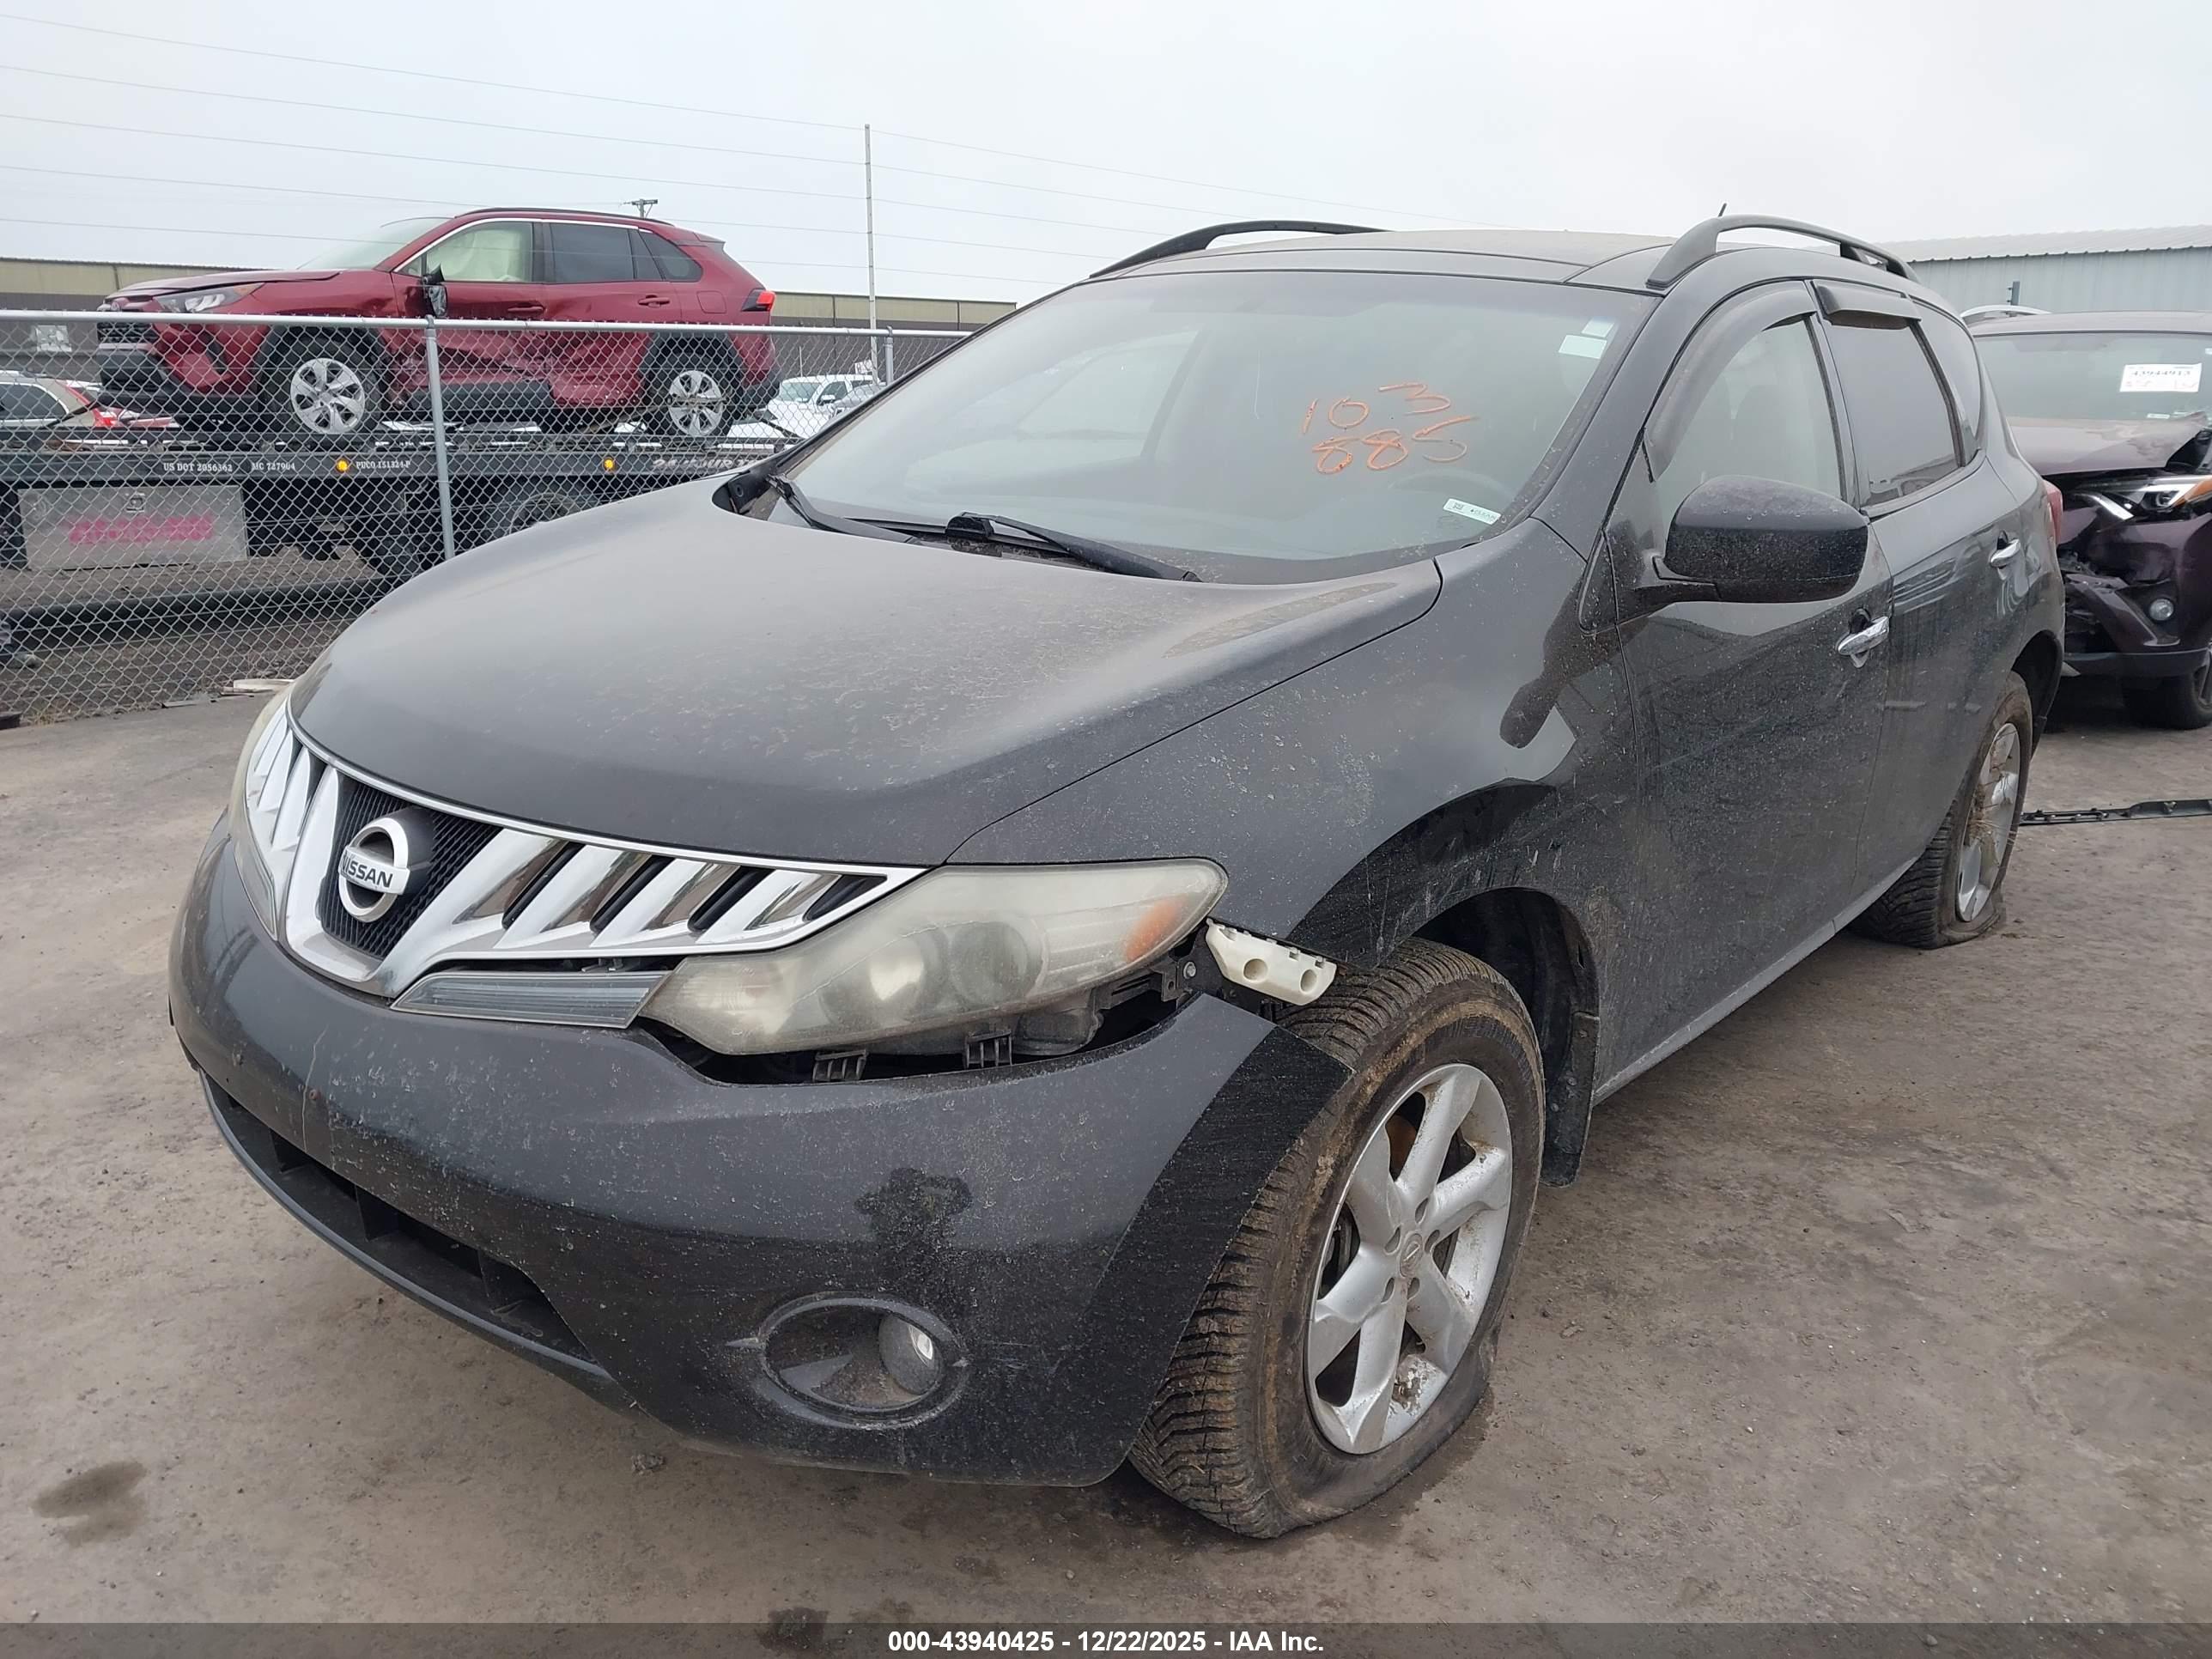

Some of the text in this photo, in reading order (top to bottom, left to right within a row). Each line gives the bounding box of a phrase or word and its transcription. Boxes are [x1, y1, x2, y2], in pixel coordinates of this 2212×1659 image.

[1312, 416, 1480, 474] 885
[163, 462, 175, 471] US
[177, 463, 194, 471] DOT
[252, 462, 264, 471] MC
[340, 851, 393, 889] NISSAN
